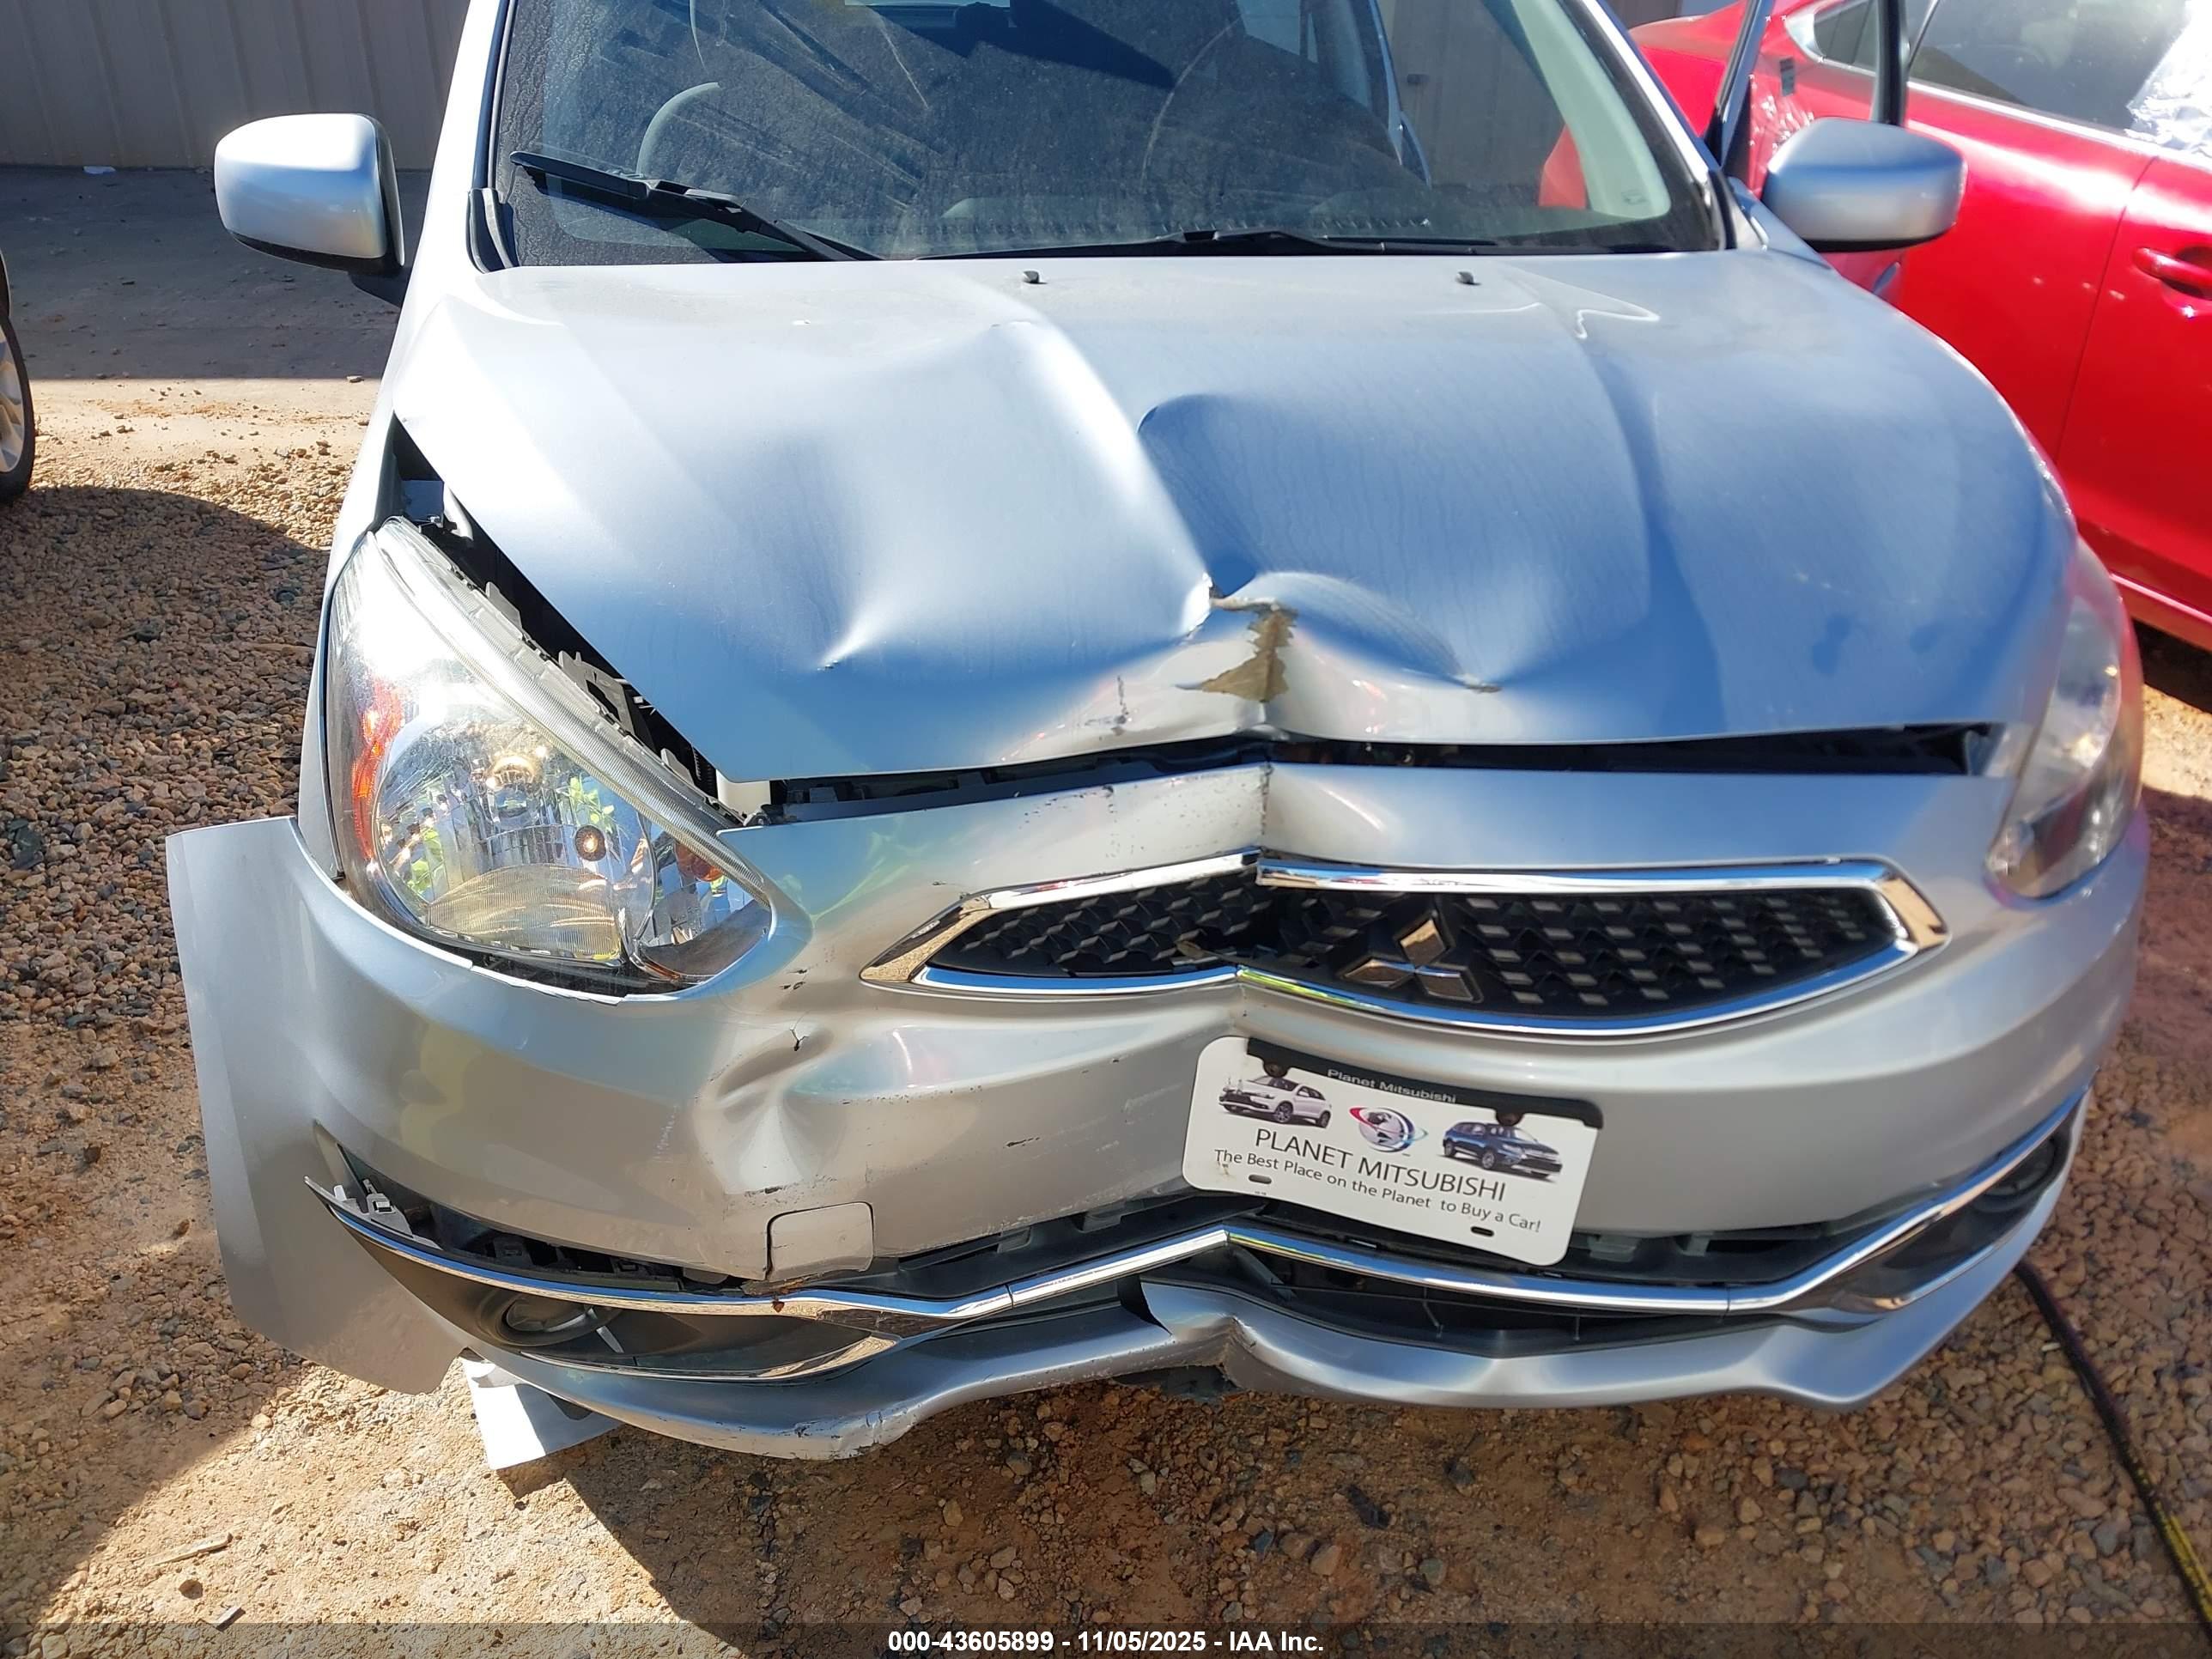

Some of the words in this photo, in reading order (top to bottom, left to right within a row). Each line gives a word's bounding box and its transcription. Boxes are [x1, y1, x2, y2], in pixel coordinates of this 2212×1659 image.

[1328, 1068, 1375, 1088] Planet
[1379, 1081, 1456, 1104] Mitsubishi
[1214, 1149, 1243, 1164] The
[1247, 1152, 1279, 1170] Best
[1284, 1160, 1322, 1181] Place
[1327, 1175, 1346, 1188] on
[1352, 1180, 1377, 1196] the
[1382, 1188, 1431, 1208] Planet
[1440, 1200, 1456, 1212] to
[1461, 1201, 1492, 1222] Buy
[1494, 1212, 1504, 1222] a
[1509, 1212, 1541, 1233] Car!
[1255, 1127, 1353, 1169] PLANET
[1358, 1157, 1506, 1201] MITSUBISHI
